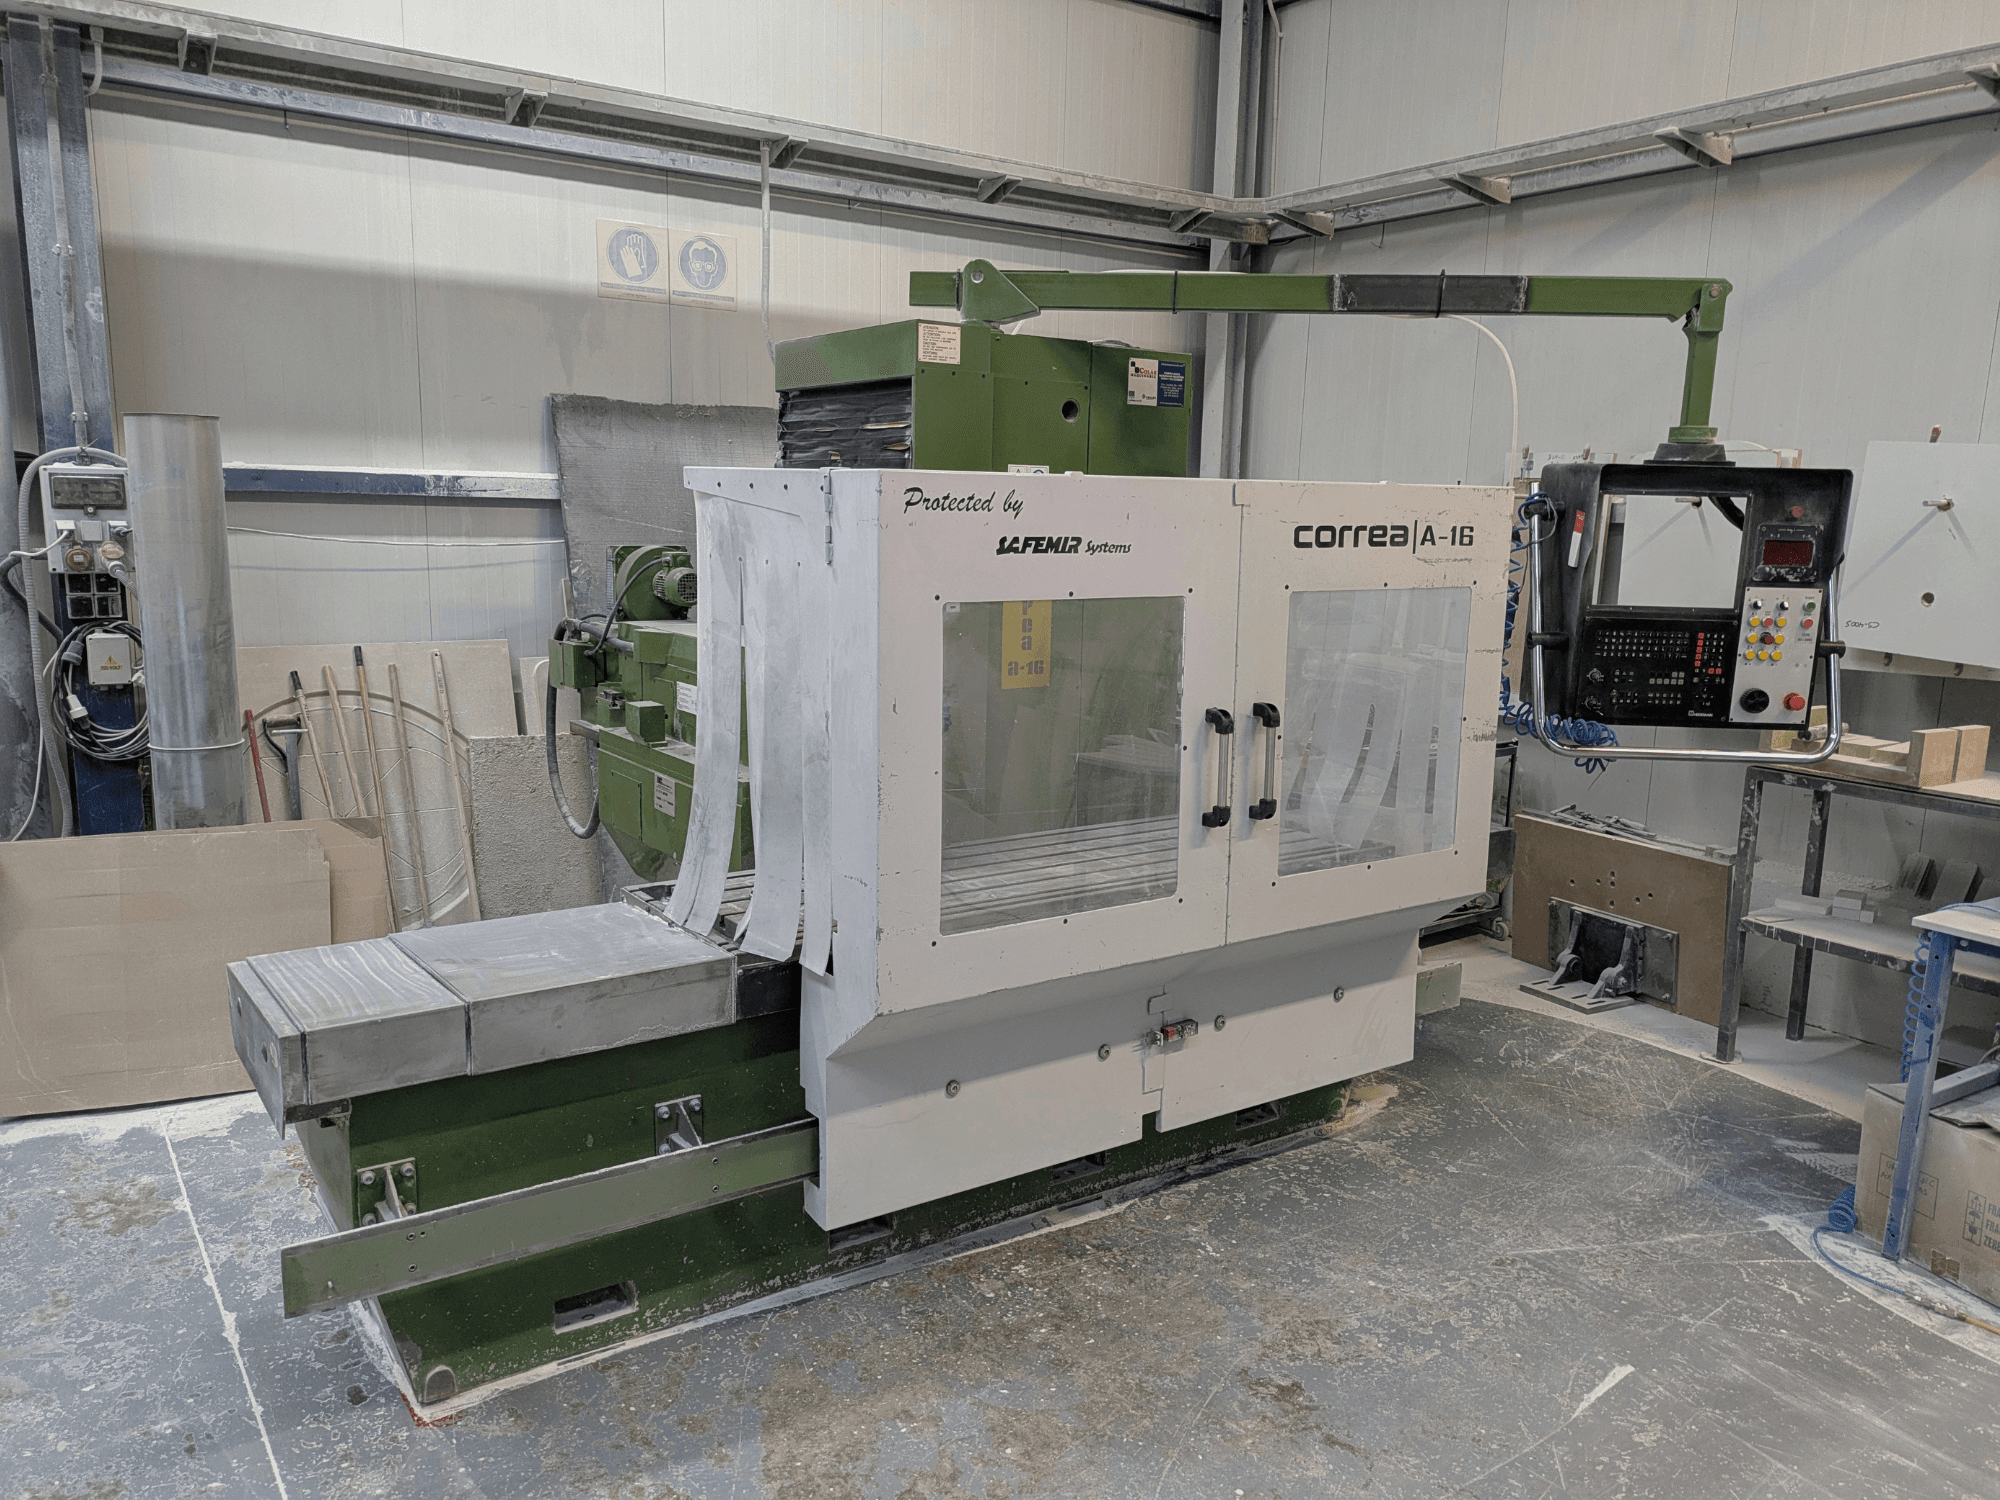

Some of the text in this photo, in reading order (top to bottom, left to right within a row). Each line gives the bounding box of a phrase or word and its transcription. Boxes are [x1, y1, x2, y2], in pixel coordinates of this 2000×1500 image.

[903, 486, 1024, 519] Protected by
[996, 536, 1132, 556] SAFEMIR Systems
[1293, 525, 1475, 548] correa A-16
